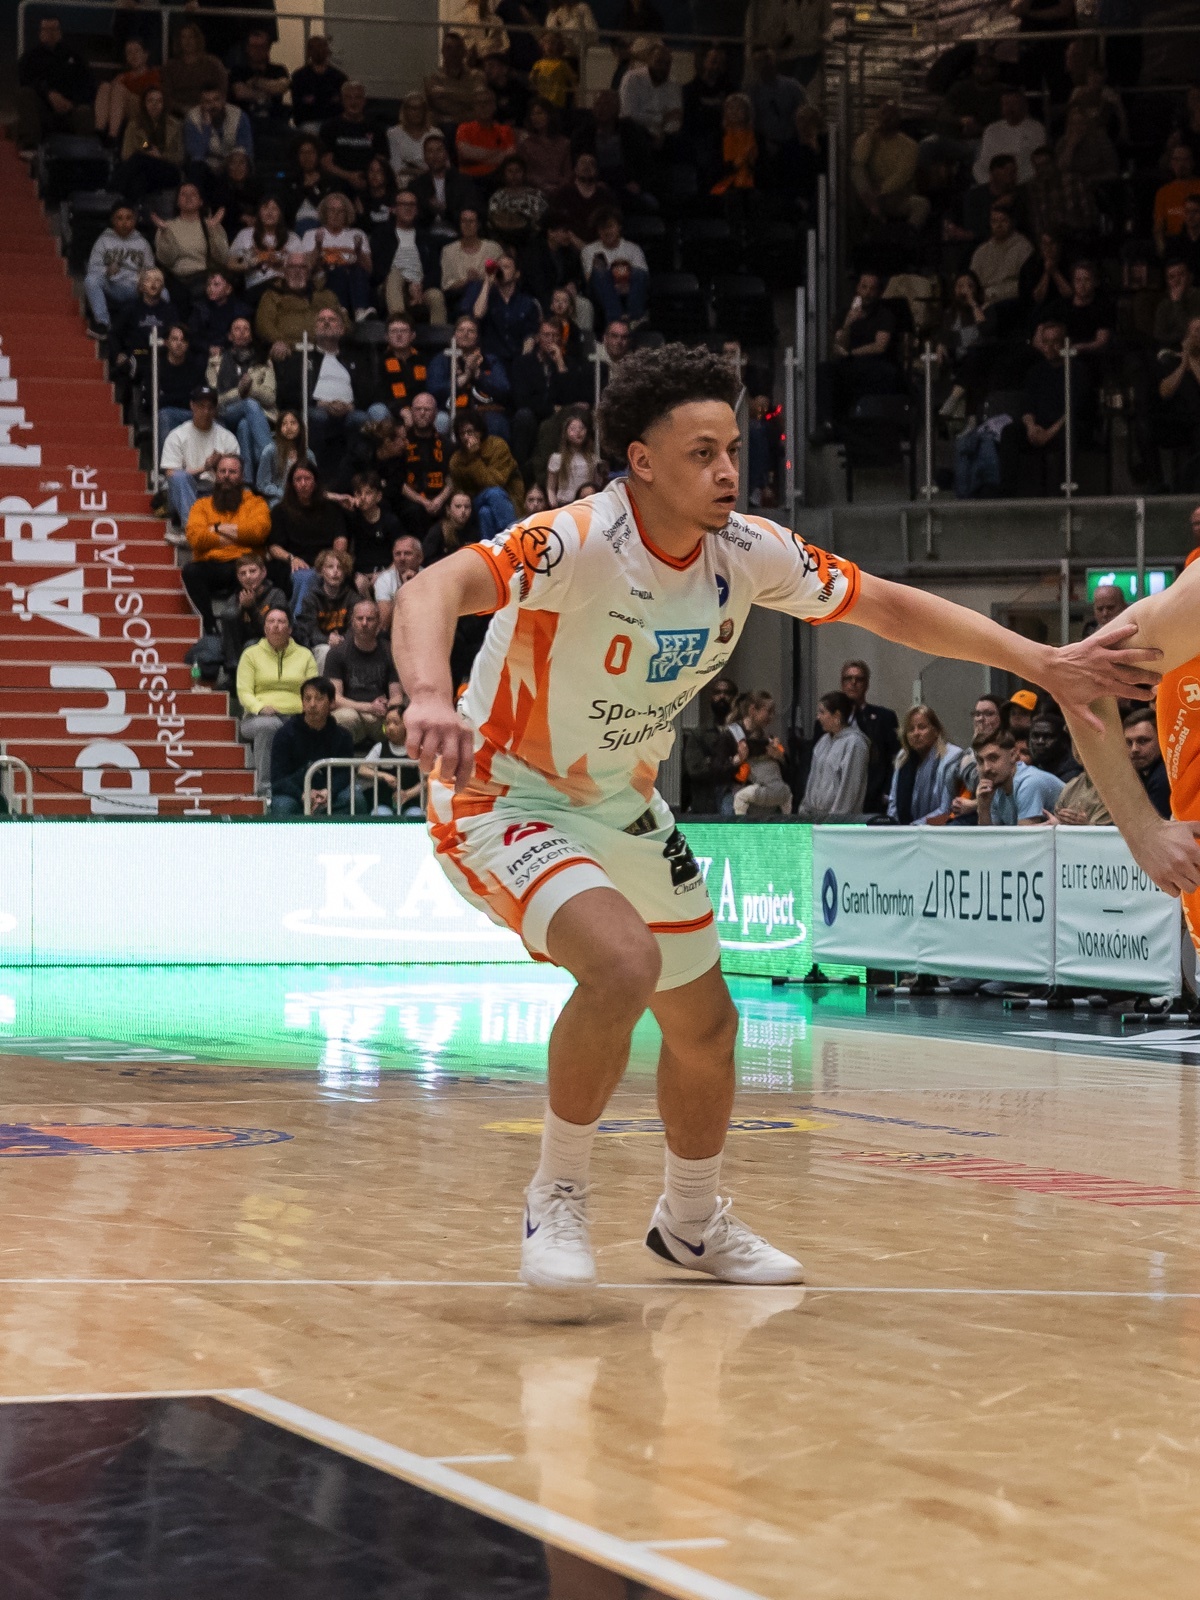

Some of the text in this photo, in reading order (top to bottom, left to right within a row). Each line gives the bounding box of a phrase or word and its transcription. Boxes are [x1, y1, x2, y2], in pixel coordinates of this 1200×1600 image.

[66, 463, 212, 817] HYRESBOSTÄDER
[604, 634, 632, 675] 0
[49, 664, 159, 816] DU
[842, 882, 914, 917] Grant Thornton
[944, 869, 1045, 923] REJLERS
[1062, 864, 1088, 889] ELITE
[1091, 864, 1129, 891] GRAND
[742, 881, 795, 936] project
[1078, 928, 1149, 961] NORRKÖPING
